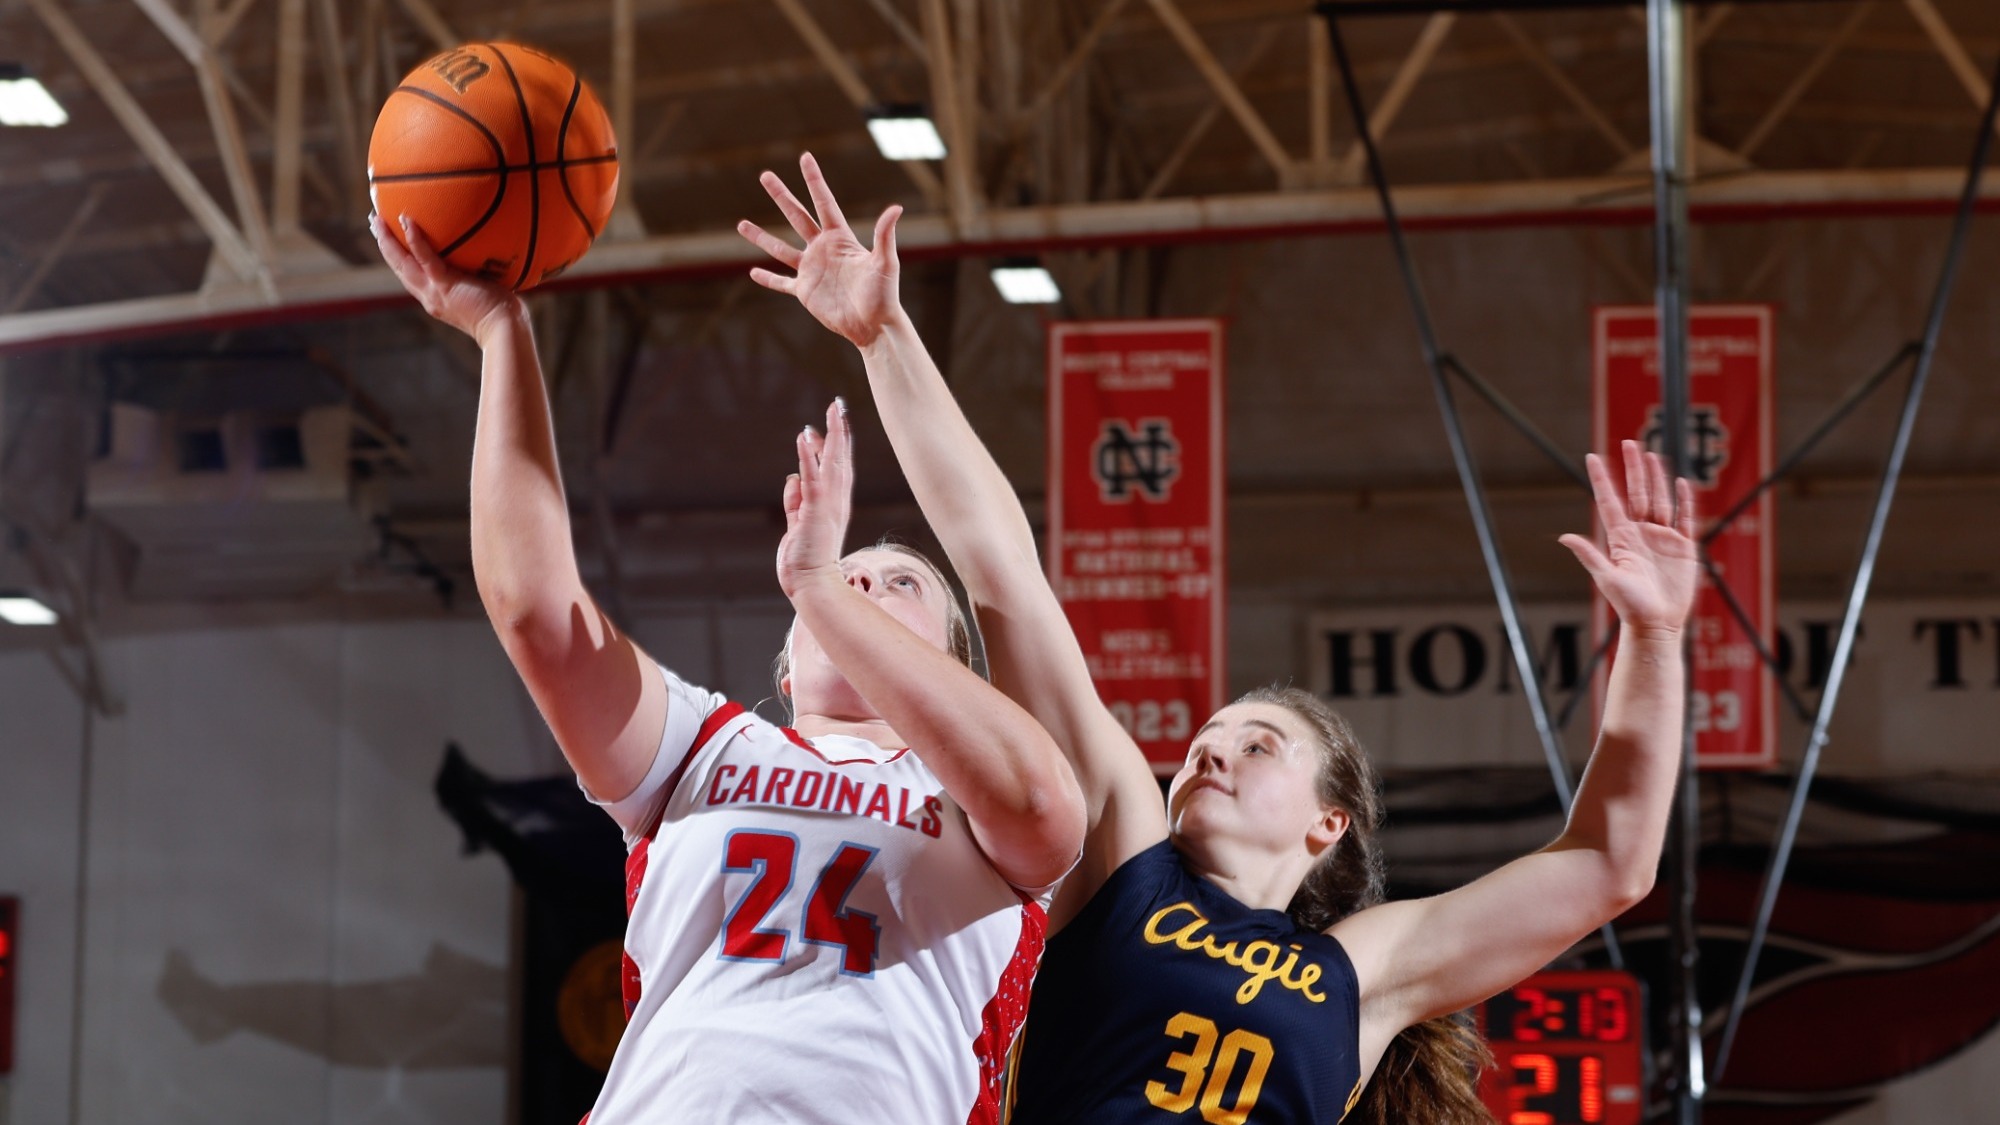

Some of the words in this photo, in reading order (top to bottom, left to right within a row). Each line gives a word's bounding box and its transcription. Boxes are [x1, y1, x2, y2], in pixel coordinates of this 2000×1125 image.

[1324, 621, 1588, 698] HOM
[1111, 699, 1192, 742] 023
[1690, 690, 1741, 733] 23
[706, 764, 943, 839] CARDINALS
[716, 827, 882, 980] 24
[1144, 1011, 1275, 1125] 30
[1508, 1053, 1603, 1125] 21
